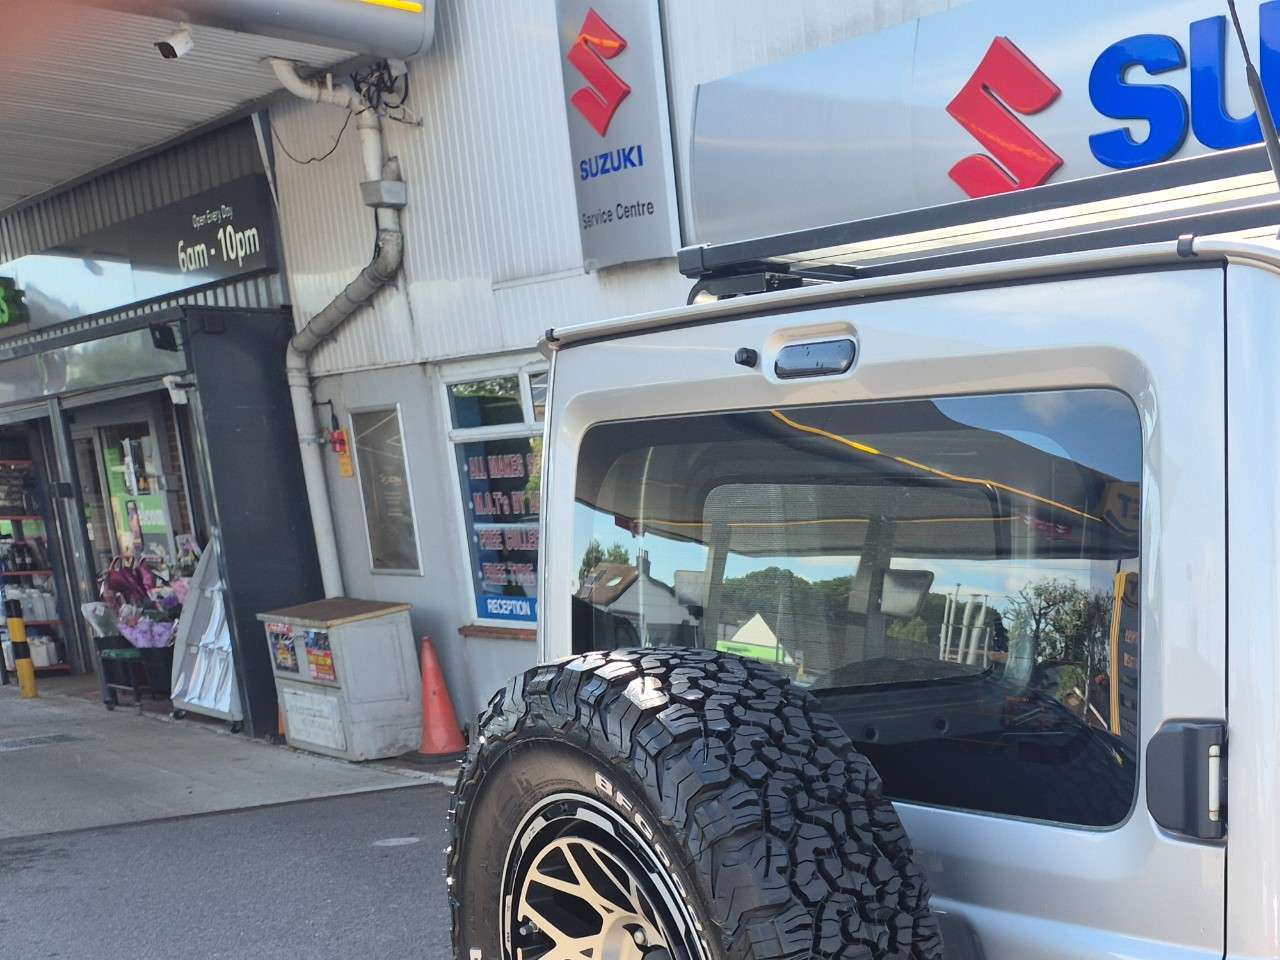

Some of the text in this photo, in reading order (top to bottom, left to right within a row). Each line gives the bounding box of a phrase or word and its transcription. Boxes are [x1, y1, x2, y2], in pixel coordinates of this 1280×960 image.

[580, 144, 643, 181] SUZUKI
[582, 201, 655, 230] Service Centre
[178, 240, 209, 273] 6am
[217, 225, 260, 268] 10pm
[486, 598, 531, 616] RECEPTION
